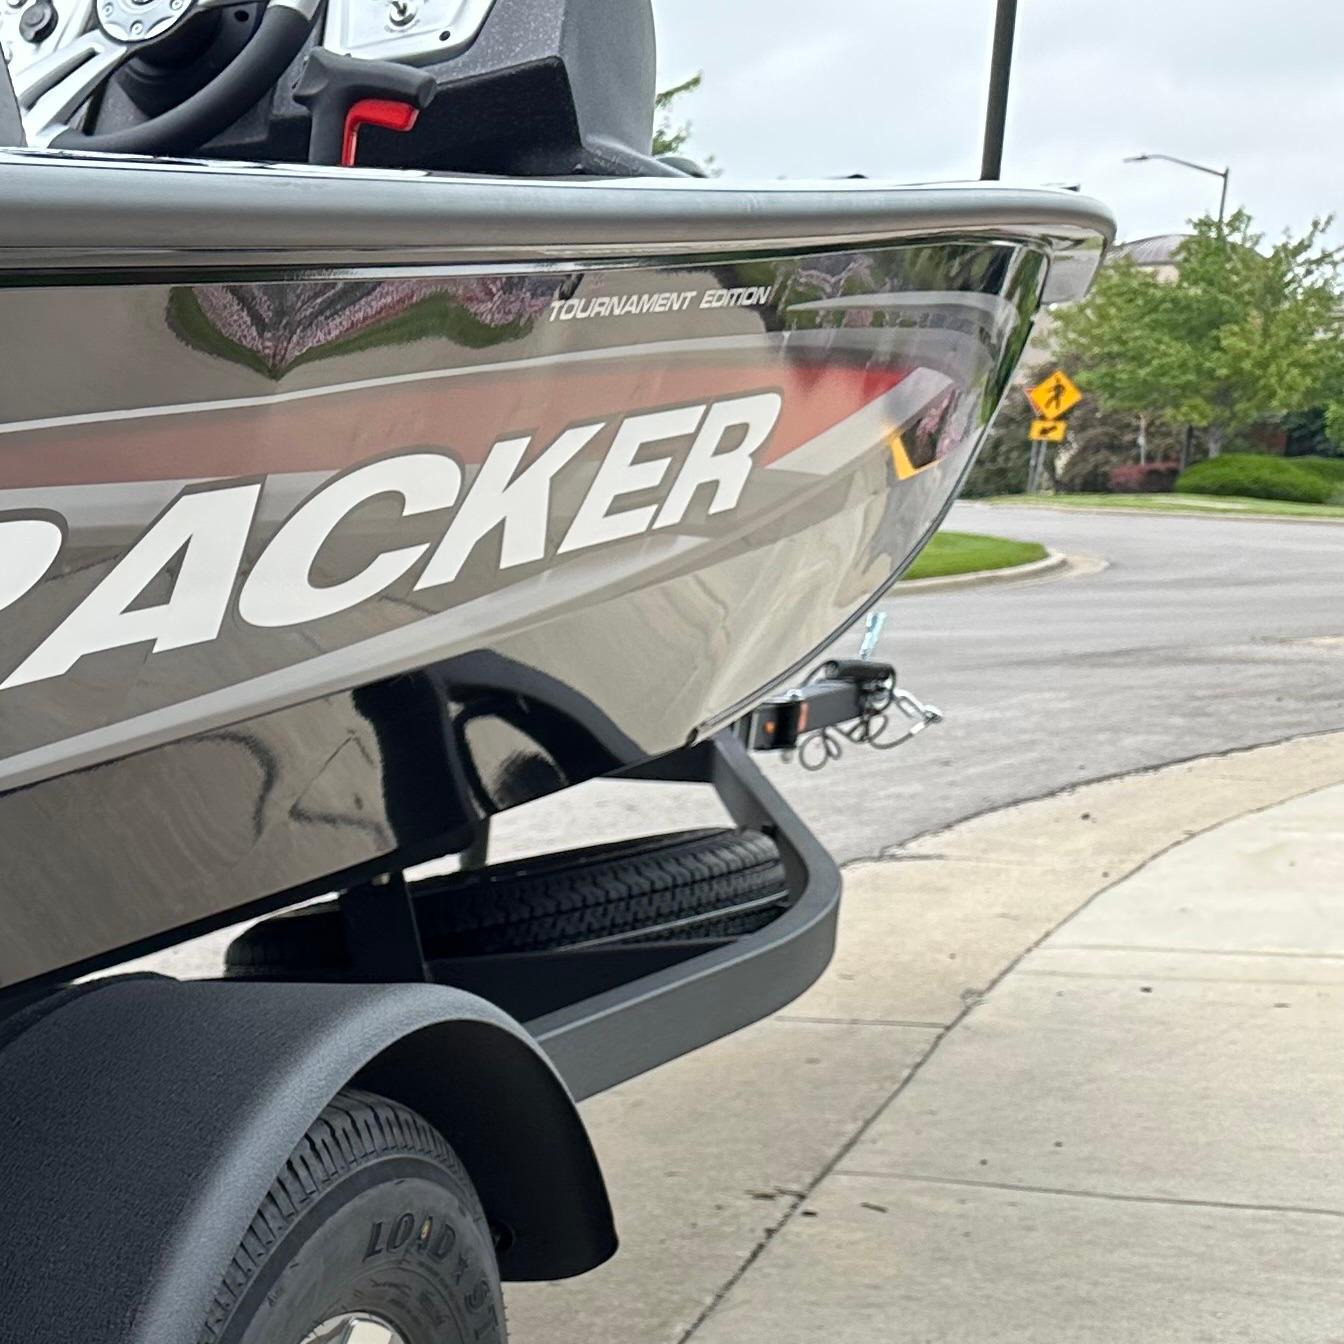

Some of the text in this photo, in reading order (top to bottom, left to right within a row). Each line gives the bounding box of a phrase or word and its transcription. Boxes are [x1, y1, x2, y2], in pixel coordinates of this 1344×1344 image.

[549, 285, 773, 322] TOURNAMENT EDITION
[363, 1212, 456, 1262] LOAD
